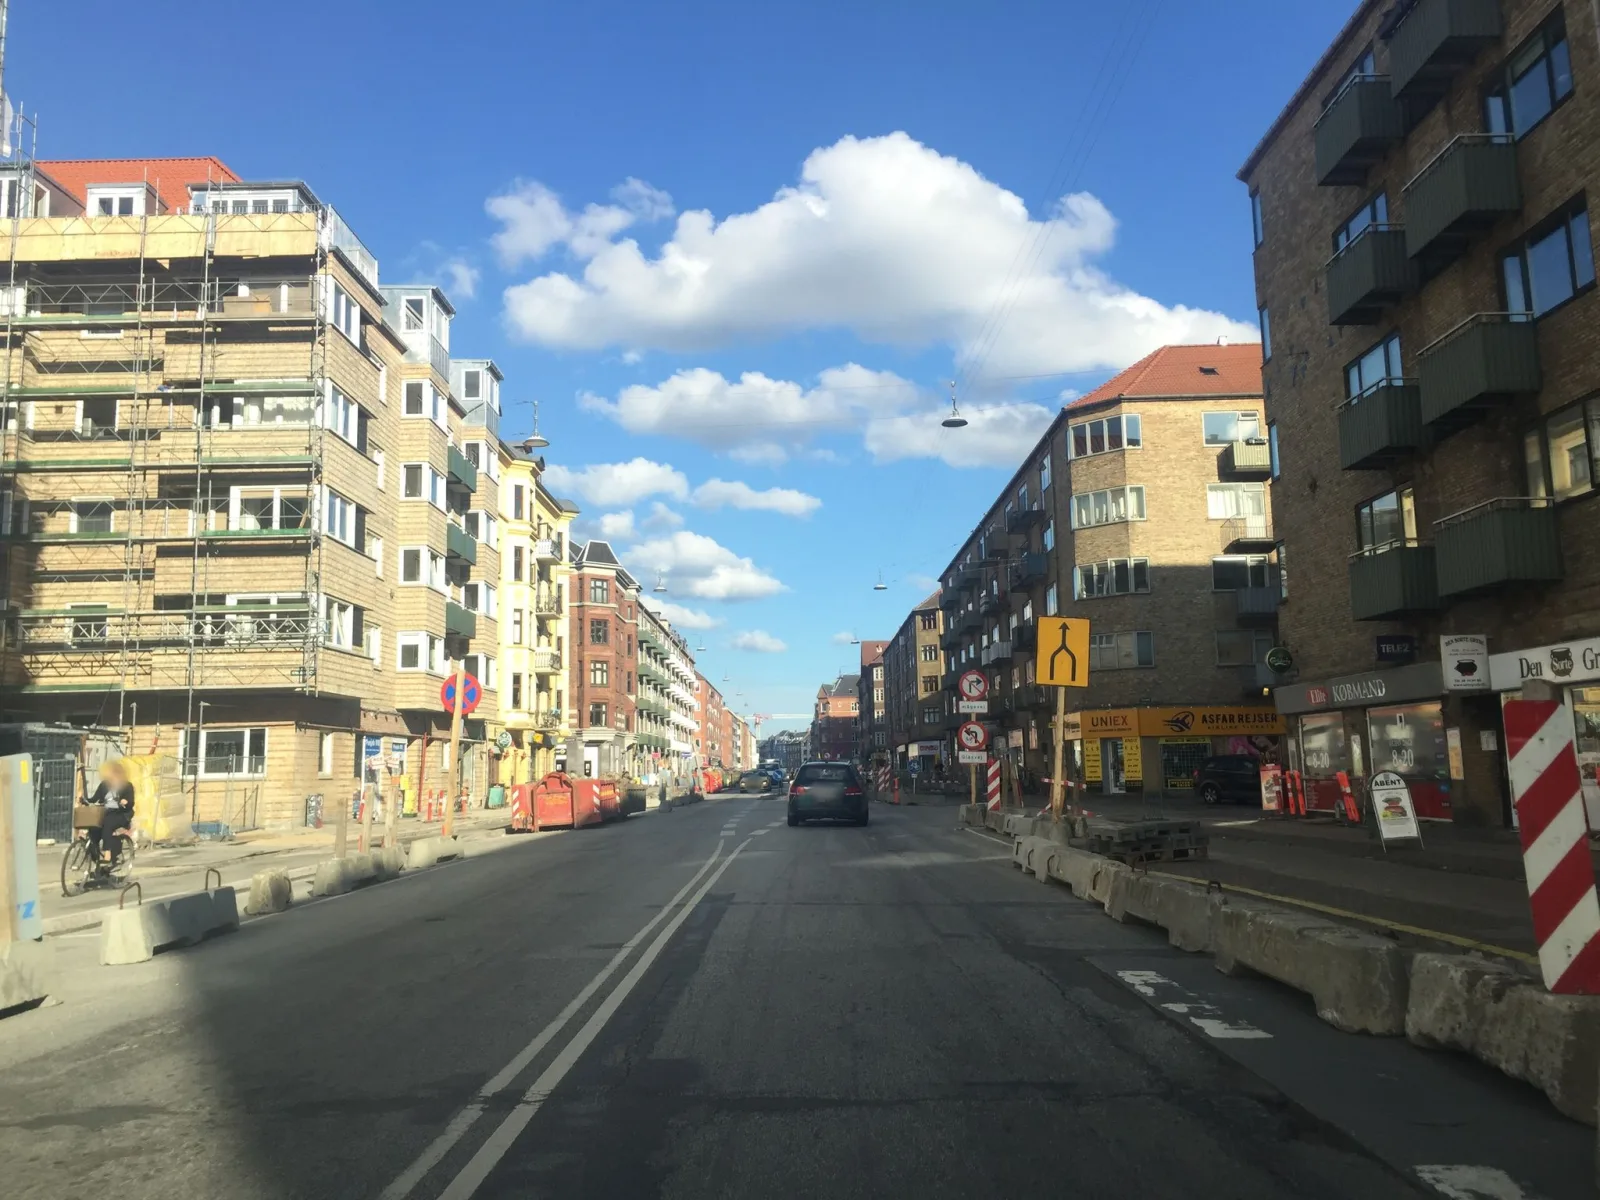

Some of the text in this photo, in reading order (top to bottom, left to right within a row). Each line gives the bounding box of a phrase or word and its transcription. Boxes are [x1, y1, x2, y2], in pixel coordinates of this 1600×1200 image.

[1519, 657, 1543, 678] Den
[1552, 657, 1573, 671] Sorte
[1332, 679, 1386, 702] KØBMAND
[1091, 715, 1128, 727] UNIEX
[1202, 713, 1278, 724] ASFAR REJSER
[1312, 752, 1330, 768] 8-20
[1392, 749, 1414, 767] 8-20
